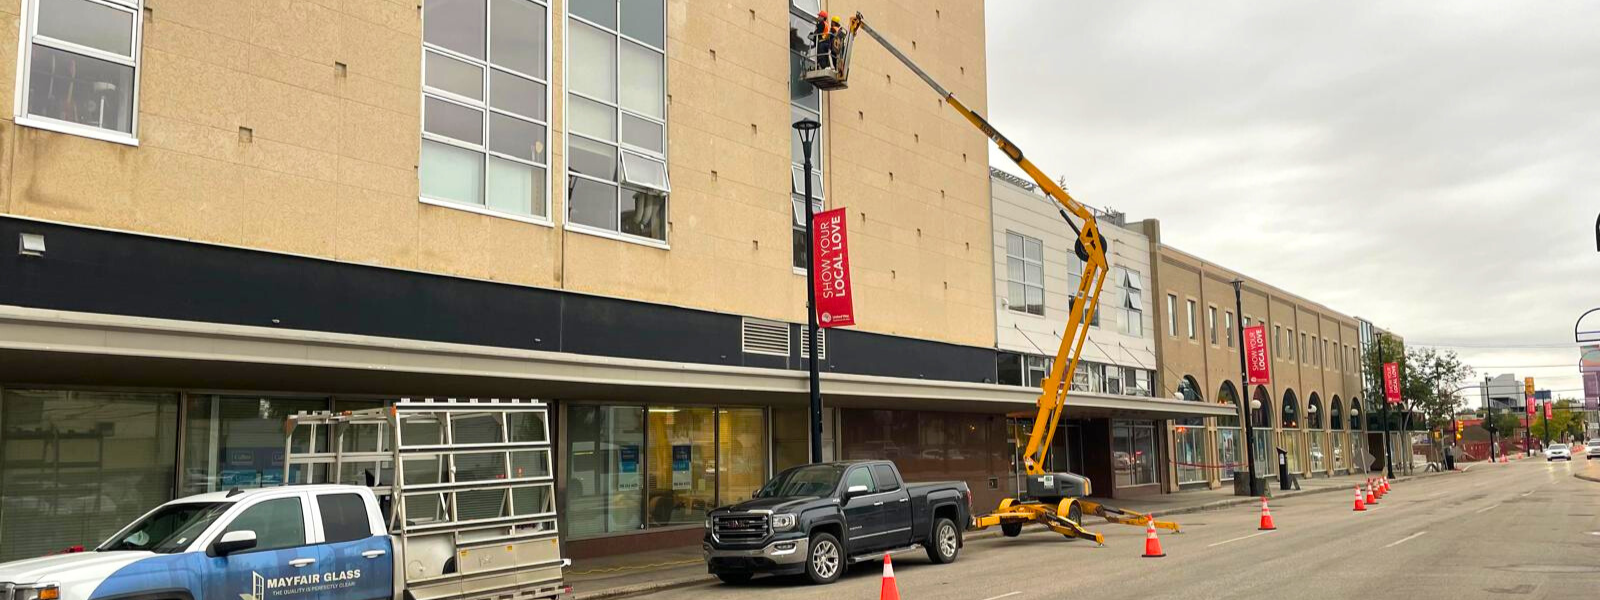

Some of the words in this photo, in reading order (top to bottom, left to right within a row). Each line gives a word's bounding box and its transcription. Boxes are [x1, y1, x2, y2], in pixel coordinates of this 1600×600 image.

[820, 222, 830, 257] YOUR
[832, 216, 841, 250] LOVE
[822, 260, 834, 298] SHOW
[834, 253, 846, 296] LOCAL
[267, 574, 320, 588] MAYFAIR
[324, 569, 360, 582] GLASS
[284, 587, 305, 595] QUALITY
